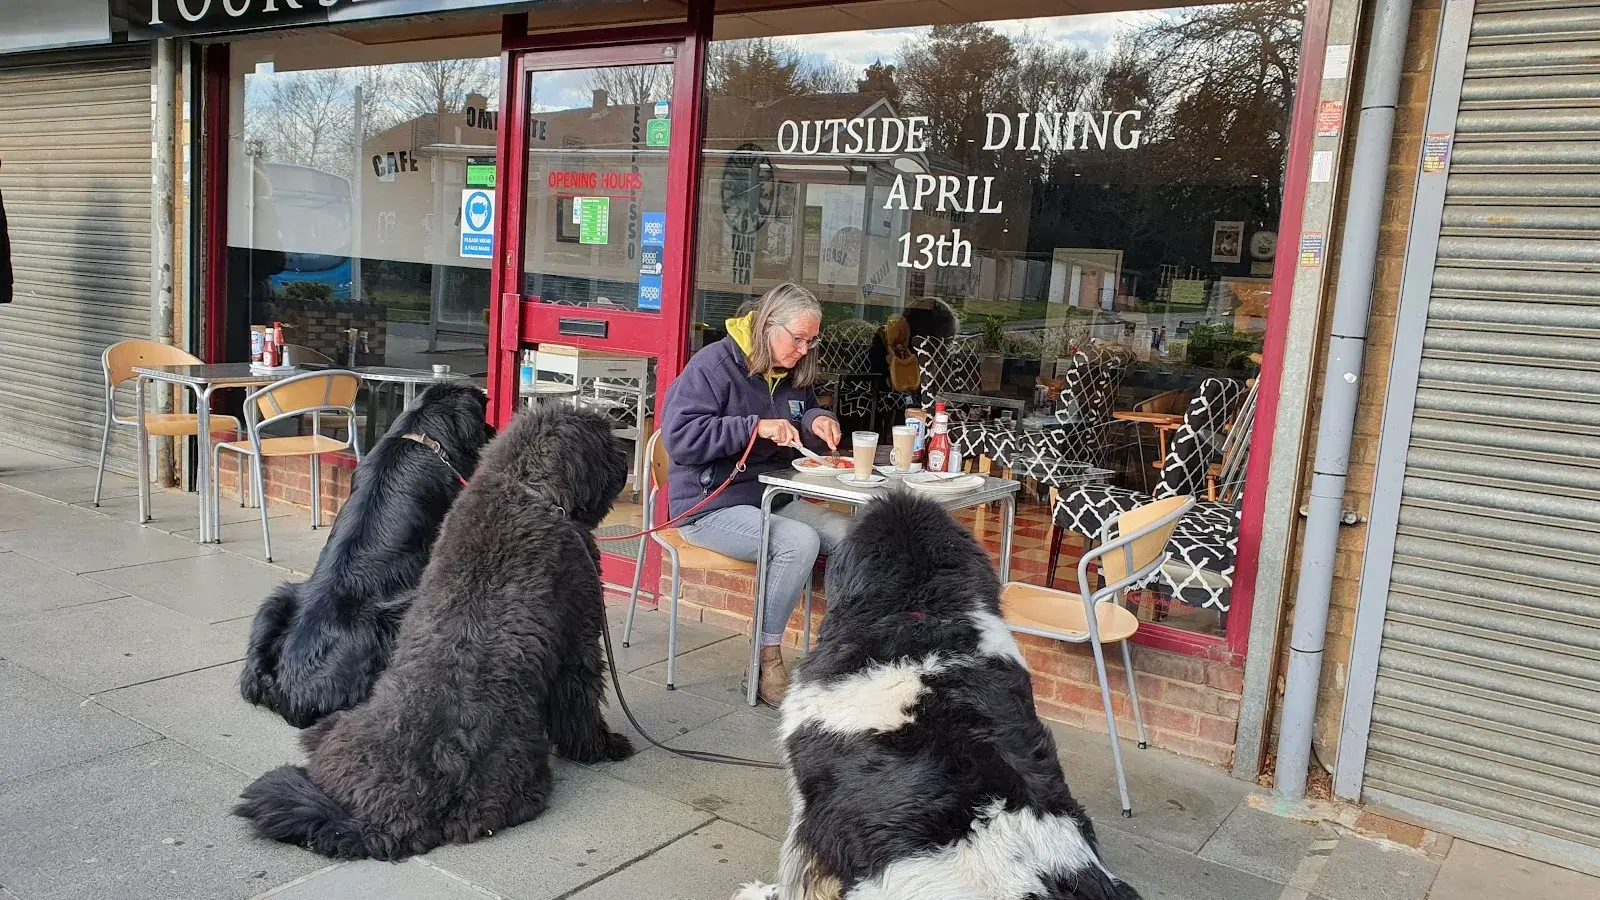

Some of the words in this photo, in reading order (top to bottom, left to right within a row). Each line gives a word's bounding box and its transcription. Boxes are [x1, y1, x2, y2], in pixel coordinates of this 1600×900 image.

[777, 116, 929, 155] OUTSIDE
[982, 110, 1142, 151] DINING
[548, 171, 597, 189] OPENING
[601, 172, 643, 190] HOURS
[883, 174, 1003, 213] APRIL
[731, 233, 756, 252] TIME
[897, 229, 972, 270] 13th
[732, 252, 752, 269] FOR
[732, 268, 751, 285] TEA
